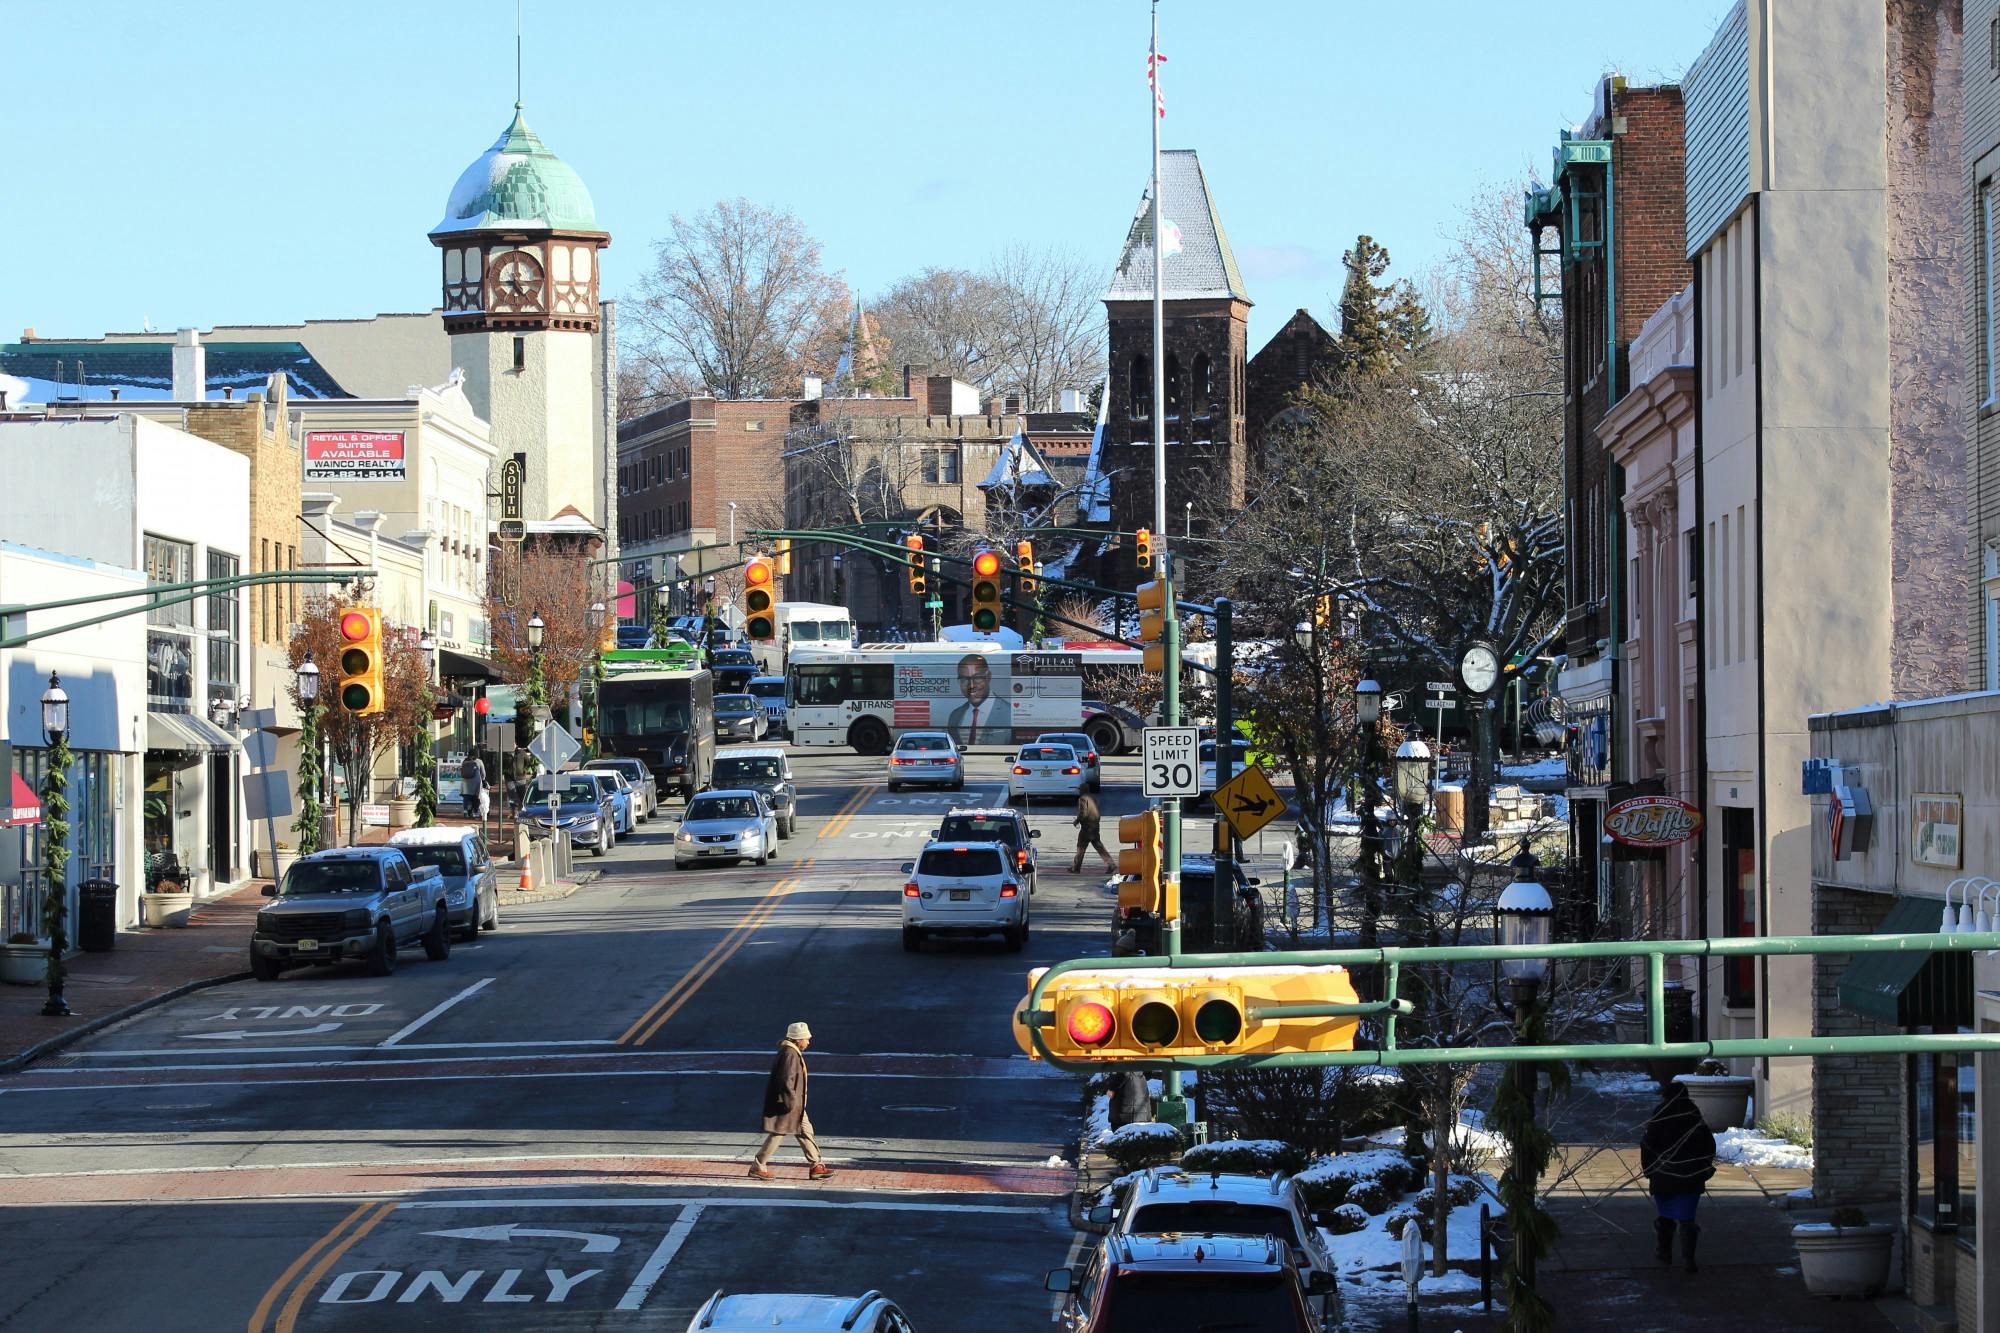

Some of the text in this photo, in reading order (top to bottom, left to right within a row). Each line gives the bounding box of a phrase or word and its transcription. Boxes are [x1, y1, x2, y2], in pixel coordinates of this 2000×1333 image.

[321, 450, 391, 458] AVAILABLE
[314, 460, 396, 468] WAINCO REALTY
[507, 464, 516, 515] SOUTH
[1034, 656, 1075, 666] PILLAR
[899, 667, 923, 677] FREE
[900, 685, 950, 693] EXPERIENCE
[1150, 735, 1192, 746] SPEED
[1153, 749, 1189, 760] LIMIT
[1151, 763, 1192, 789] 30
[1624, 798, 1680, 808] GRID IRON
[1610, 807, 1693, 839] Waffle
[849, 831, 932, 839] ONL
[1669, 829, 1691, 840] Shop
[200, 1003, 385, 1021] ONLY
[319, 1269, 604, 1303] ONLY
